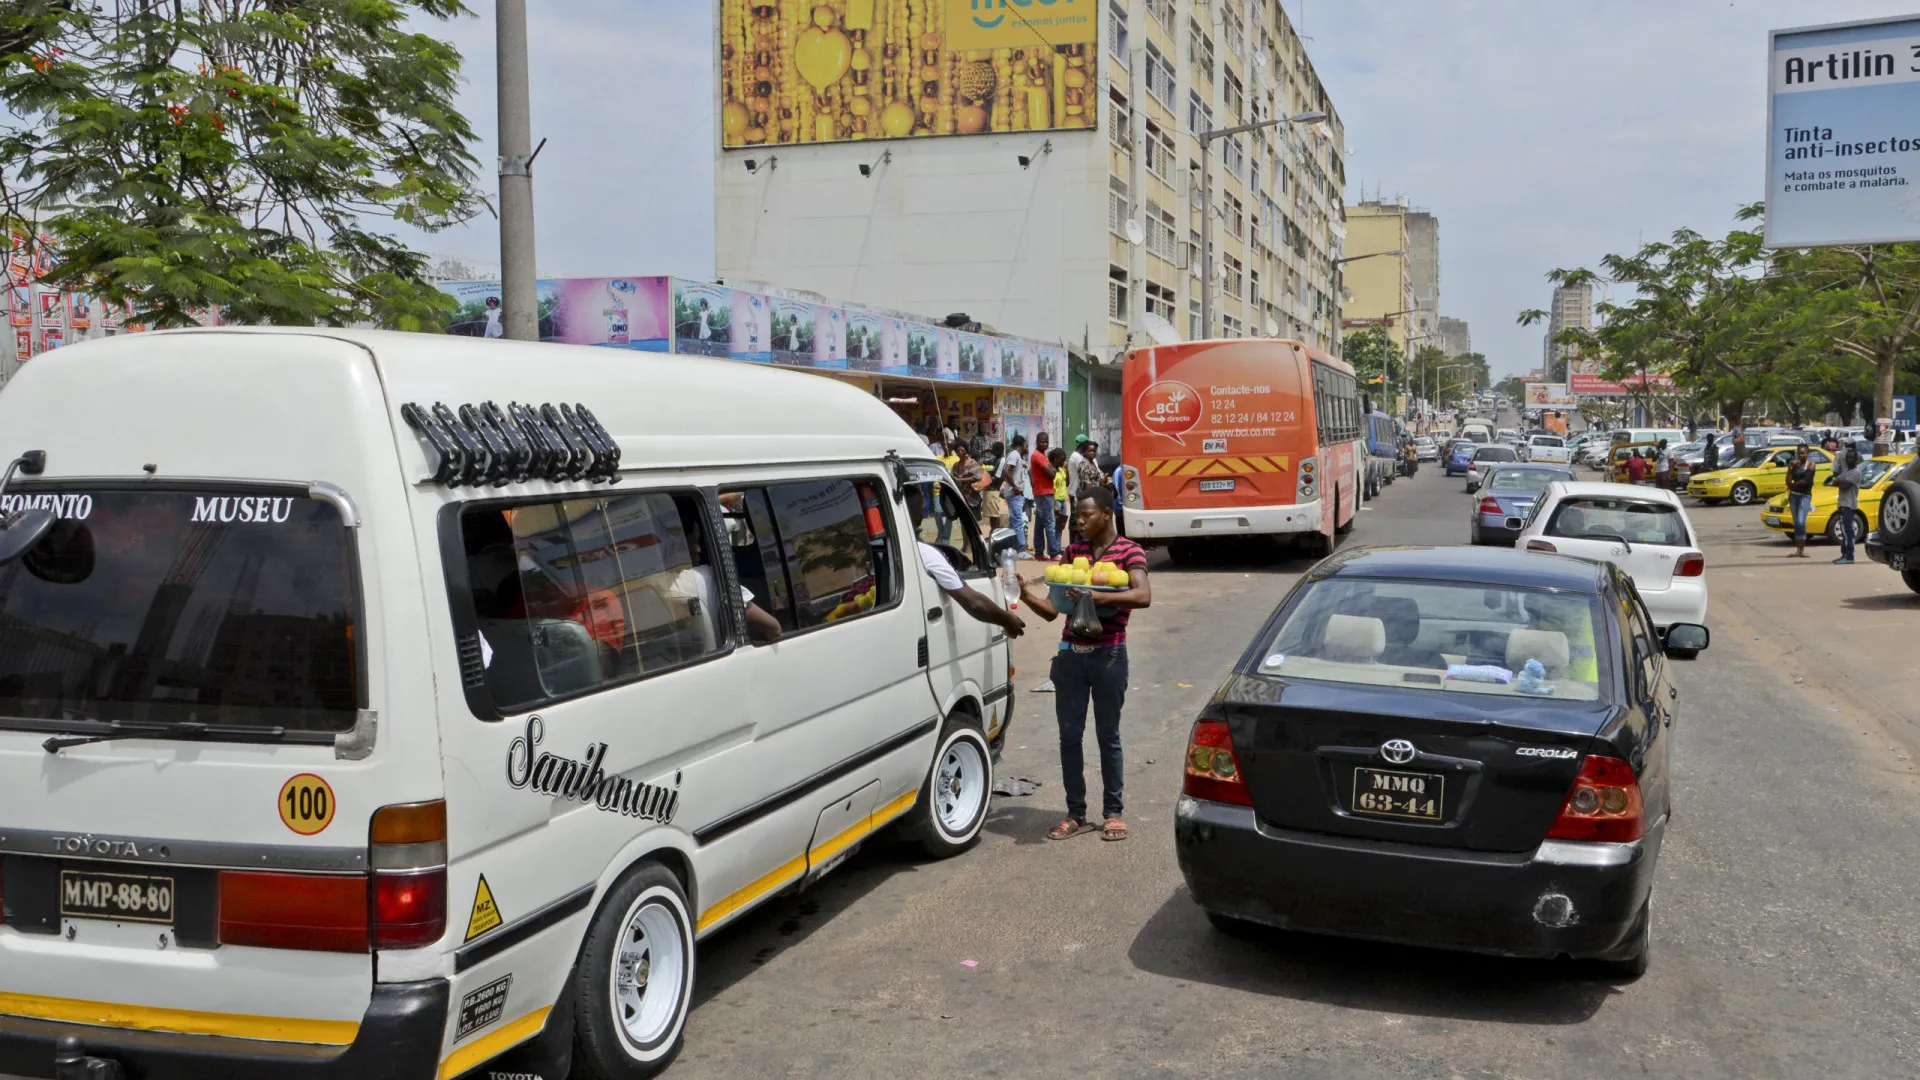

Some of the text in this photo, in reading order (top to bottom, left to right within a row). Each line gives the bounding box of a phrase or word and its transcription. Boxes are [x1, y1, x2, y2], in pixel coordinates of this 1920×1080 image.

[1012, 15, 1087, 27] estamos juntos
[1785, 50, 1894, 84] Artilin
[1784, 126, 1832, 143] Tinta
[1785, 137, 1920, 159] anti-insectos
[1785, 165, 1896, 181] Mata os mosquitos
[1784, 184, 1791, 192] e
[1795, 181, 1845, 192] combate
[1849, 180, 1856, 189] a
[612, 324, 628, 332] OMO
[1210, 384, 1270, 396] Contacte-nos
[1156, 403, 1179, 414] BCI
[1211, 399, 1235, 410] 12 24
[1892, 398, 1906, 419] P
[1225, 413, 1235, 423] 12
[1238, 413, 1249, 422] 24
[1271, 412, 1281, 421] 12
[1284, 411, 1295, 421] 24
[1211, 427, 1276, 438] www.bci.co.mz
[0, 494, 293, 522] FOMENTO MUSEU
[1516, 747, 1578, 759] COROLLA
[506, 714, 683, 824] Sanibonani
[1373, 774, 1426, 793] MMQ
[286, 786, 327, 820] 100
[1359, 792, 1437, 815] 63-44
[52, 834, 139, 857] TOYOTA
[64, 879, 171, 912] MMP-88-80
[476, 900, 491, 914] MZ
[495, 981, 506, 993] KG
[492, 995, 504, 1007] KG
